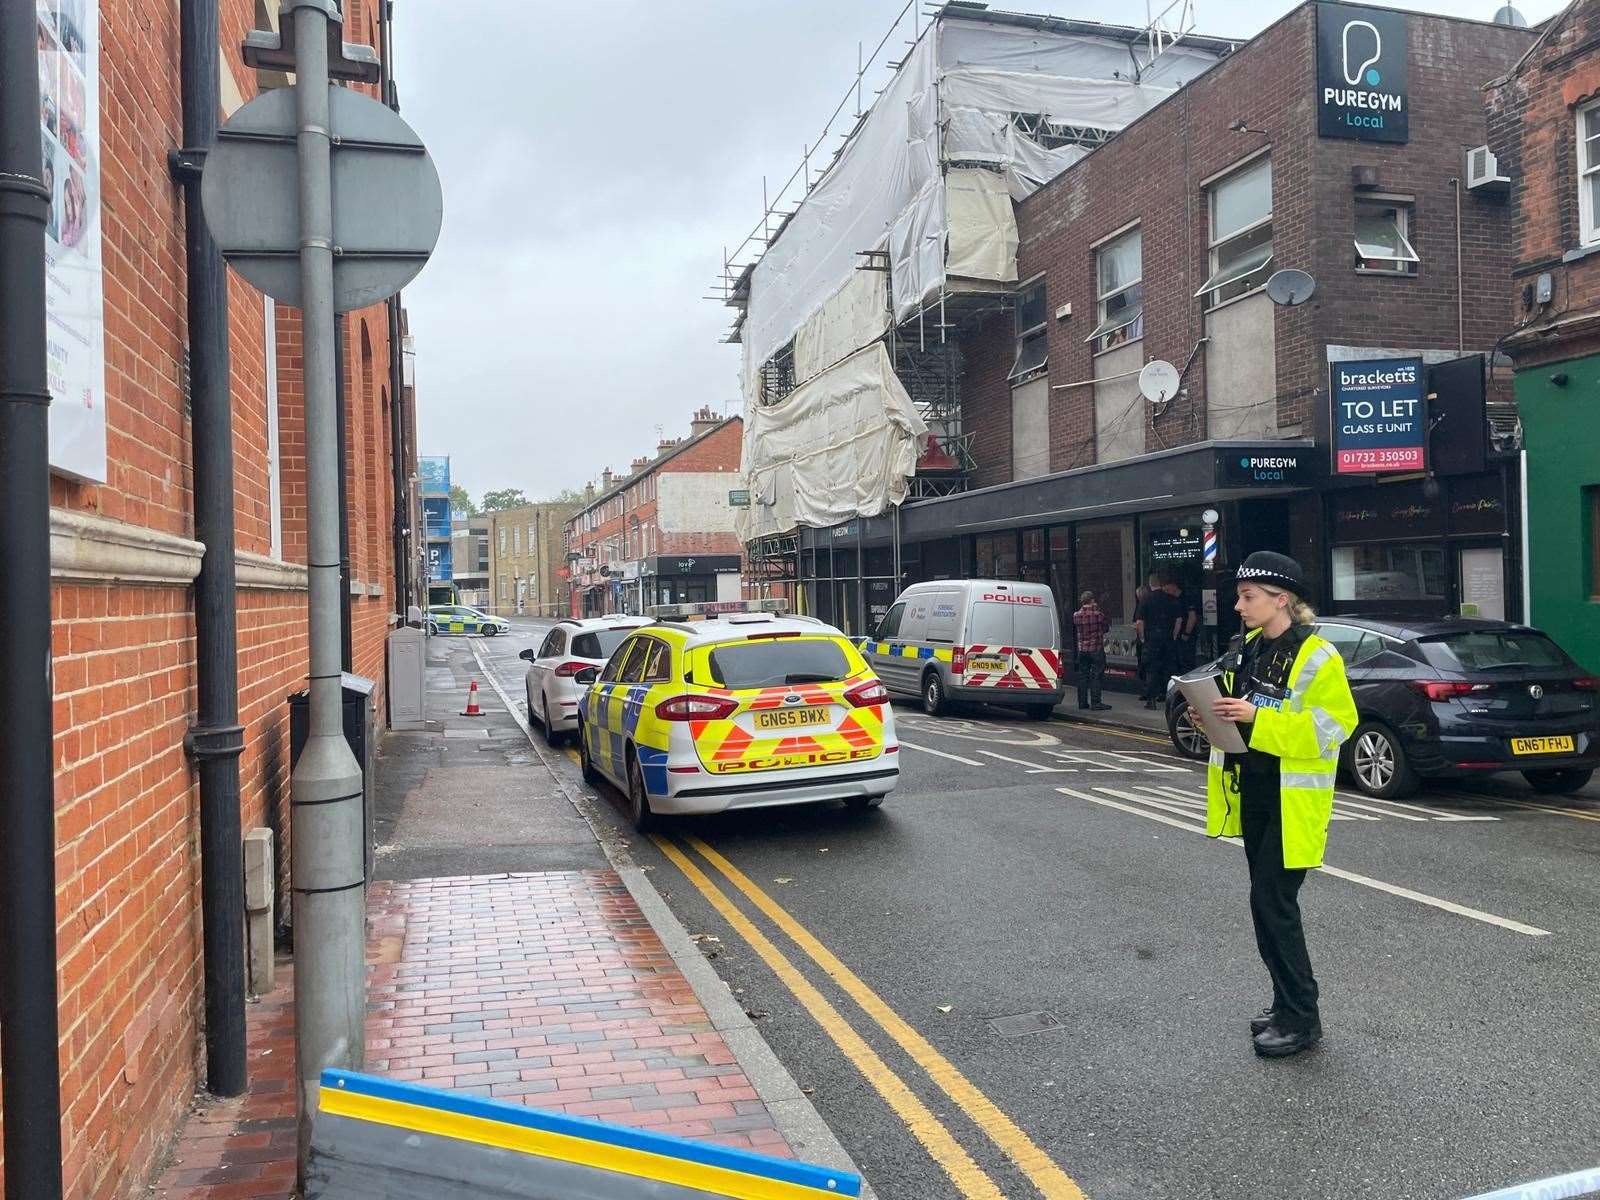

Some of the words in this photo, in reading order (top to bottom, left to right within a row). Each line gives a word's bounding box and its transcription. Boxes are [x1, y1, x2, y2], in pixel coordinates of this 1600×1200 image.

[1324, 87, 1401, 112] PUREGYM
[1346, 112, 1384, 128] Local
[1341, 369, 1416, 385] bracketts
[1341, 401, 1374, 419] TO
[1381, 399, 1418, 418] LET
[1342, 424, 1375, 434] CLASS
[1376, 424, 1383, 433] E
[1386, 422, 1413, 432] UNIT
[1250, 457, 1297, 468] PUREGYM
[1343, 453, 1376, 463] 01732
[1378, 450, 1418, 462] 350503
[1254, 469, 1284, 481] Local
[430, 549, 439, 560] P
[983, 594, 1043, 605] POLICE
[971, 661, 990, 670] GN09
[990, 662, 1005, 670] NNE
[1253, 695, 1281, 711] POLIC
[760, 711, 796, 728] GN65
[801, 710, 826, 724] BWX
[1516, 739, 1547, 752] GN67
[1549, 738, 1570, 750] FHJ
